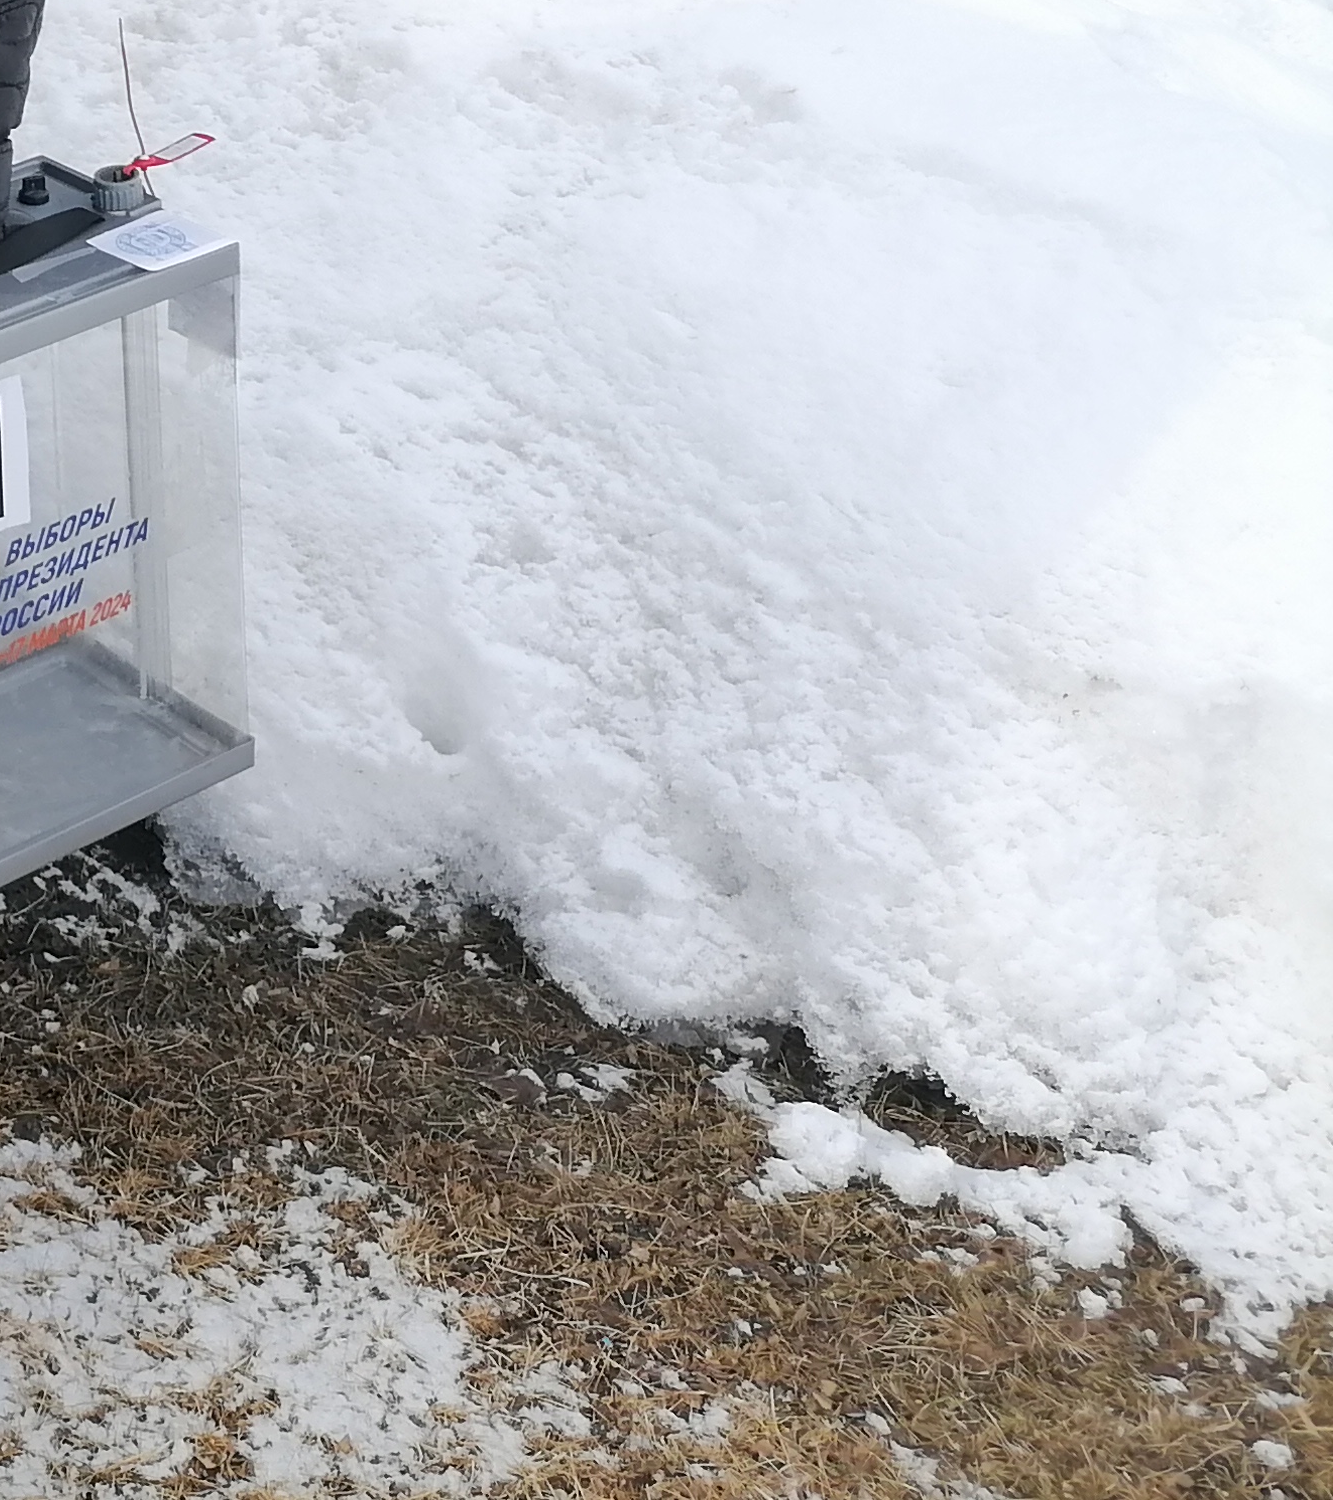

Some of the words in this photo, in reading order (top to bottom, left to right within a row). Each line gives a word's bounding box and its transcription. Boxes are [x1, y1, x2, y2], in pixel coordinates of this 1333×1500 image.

[4, 496, 116, 568] ВЫБОРЫ
[27, 609, 87, 655] МАРТА
[89, 589, 132, 627] 2024
